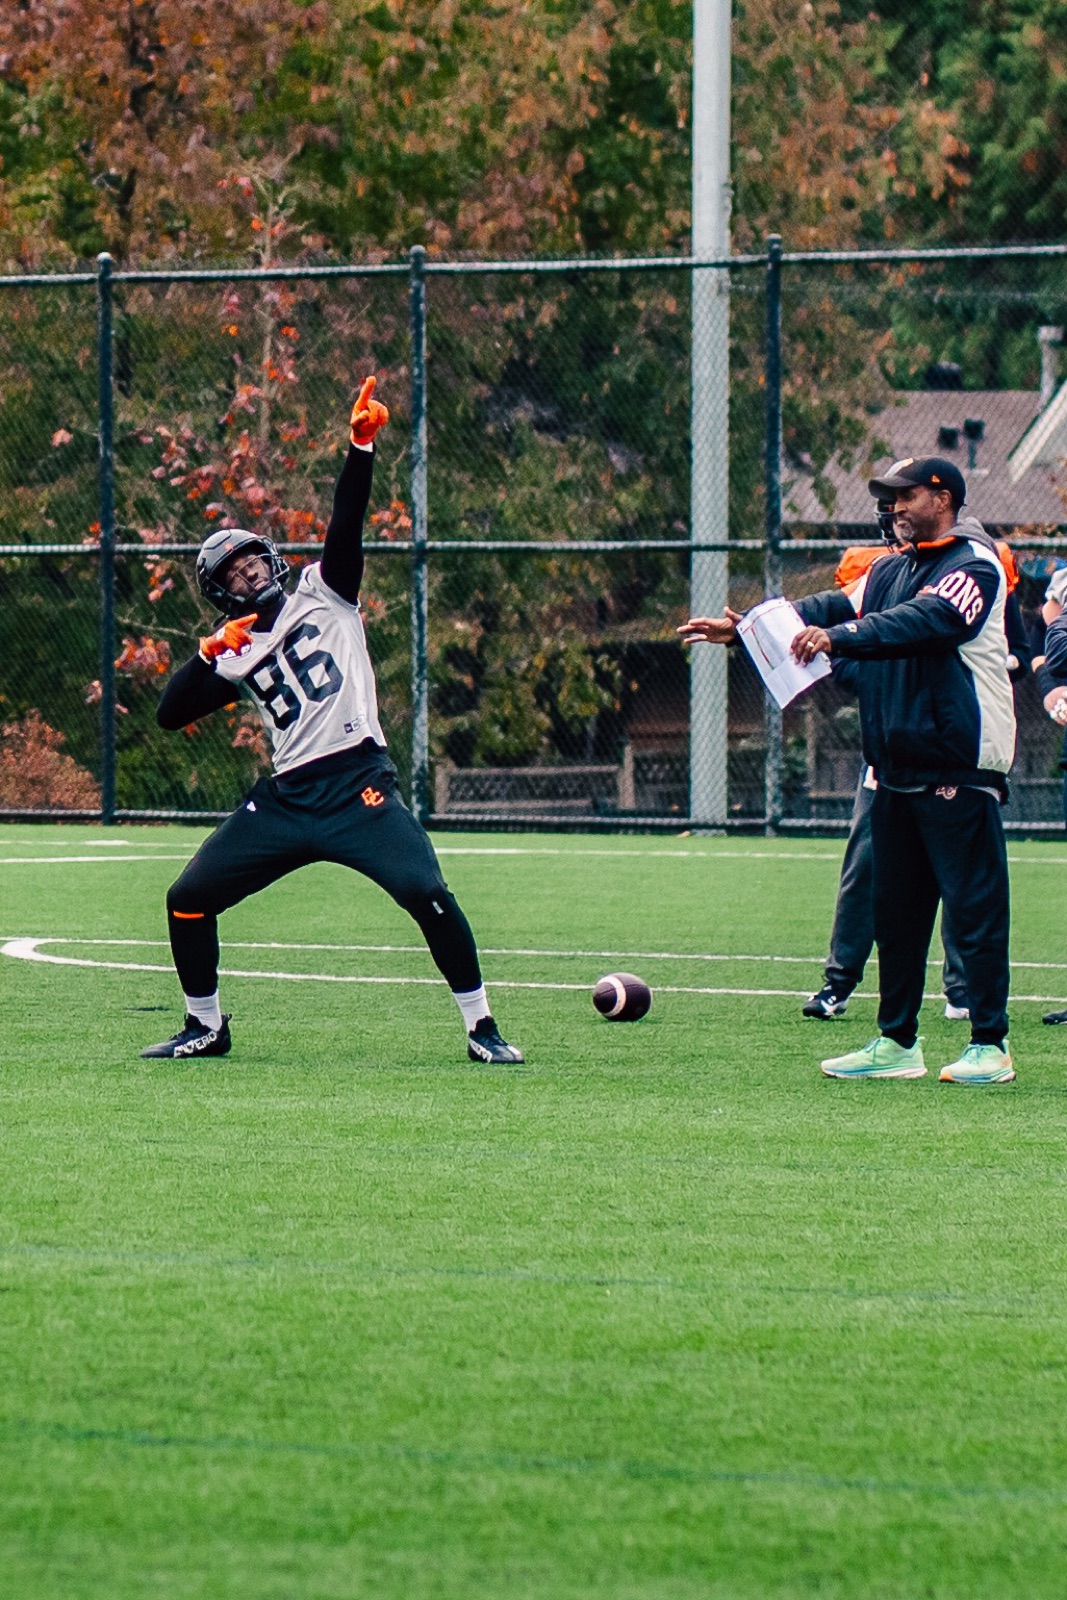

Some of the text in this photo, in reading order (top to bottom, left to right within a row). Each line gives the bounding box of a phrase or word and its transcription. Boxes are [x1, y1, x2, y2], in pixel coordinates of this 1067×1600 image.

[930, 570, 984, 626] IONS
[244, 622, 344, 732] 86
[360, 786, 385, 807] BC
